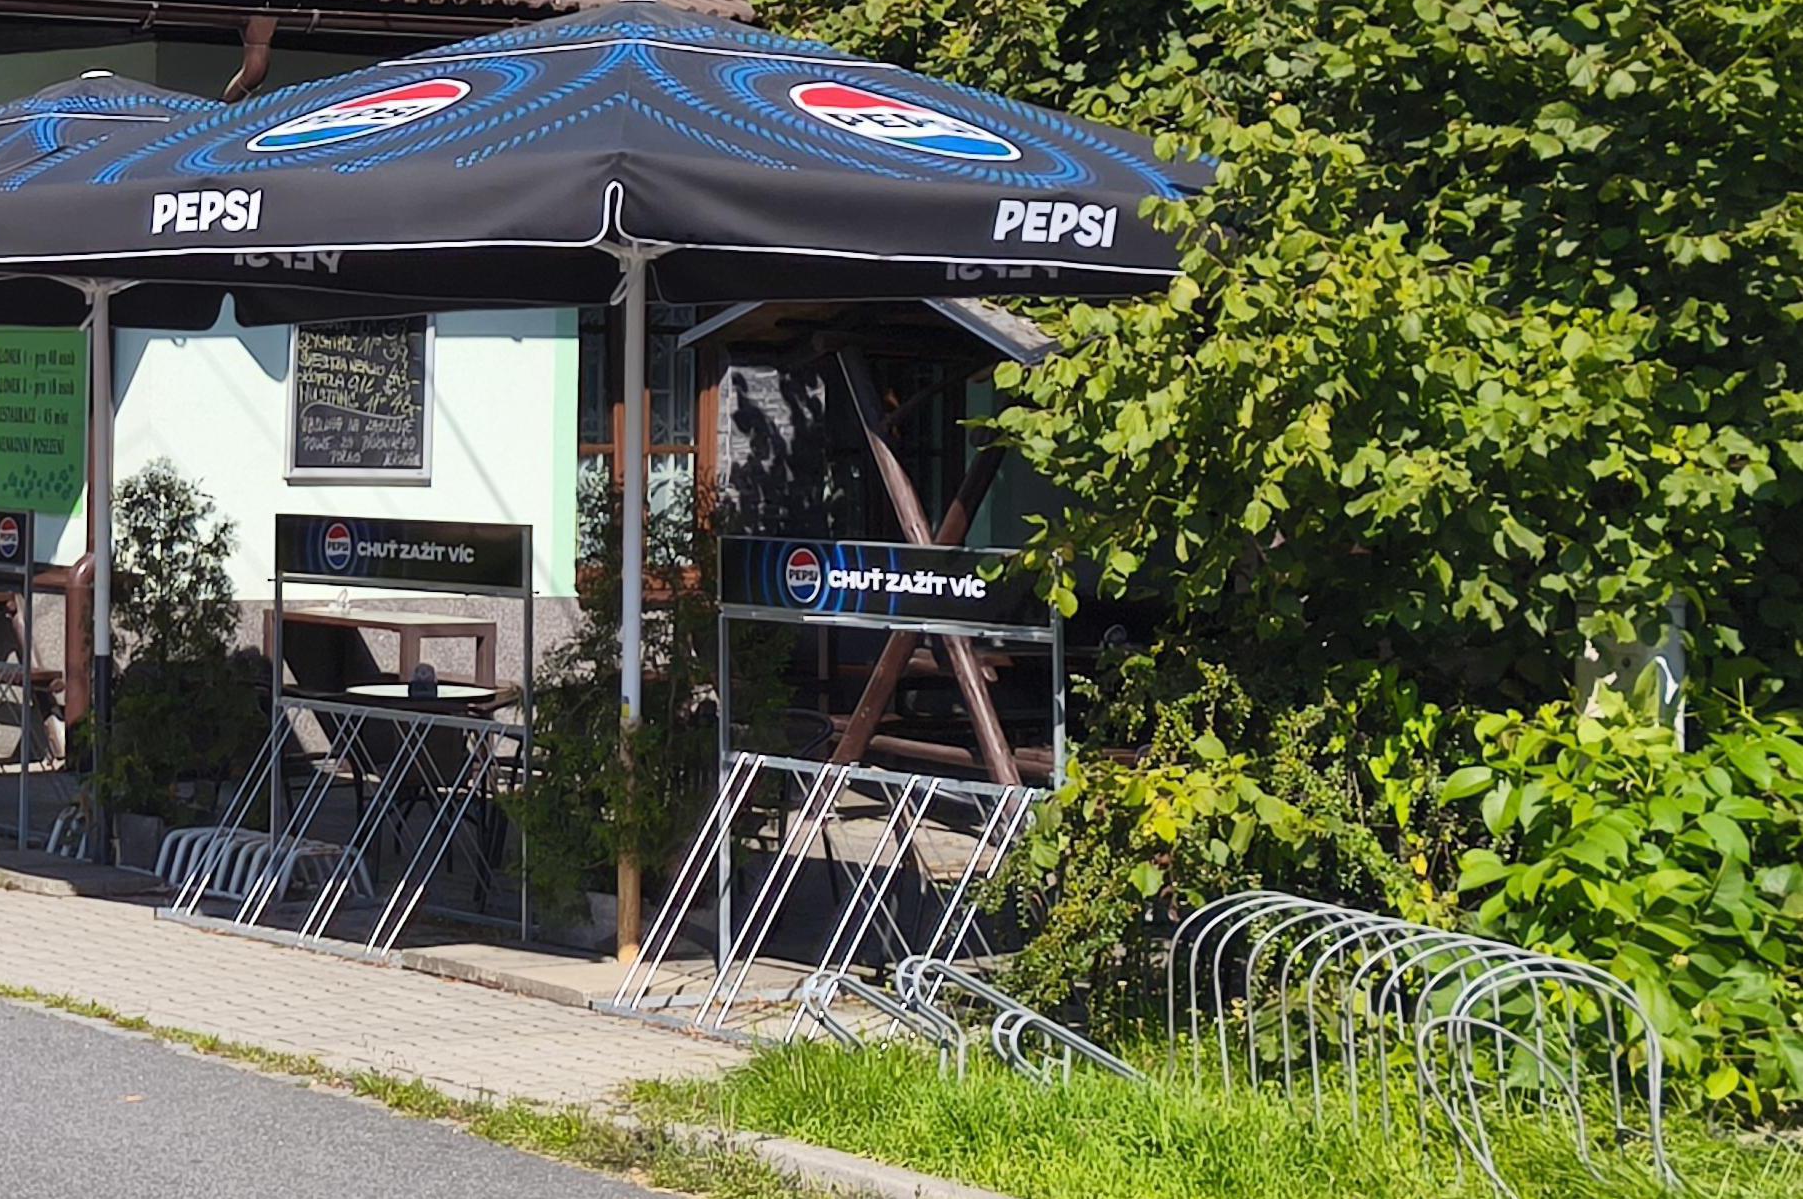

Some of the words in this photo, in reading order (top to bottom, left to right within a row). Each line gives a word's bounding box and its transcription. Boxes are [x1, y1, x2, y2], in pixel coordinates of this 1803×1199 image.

[151, 189, 263, 234] PEPSI
[993, 200, 1117, 248] PEPSI
[357, 540, 398, 559] CHUŤ
[400, 541, 445, 561] ZAŽÍT
[449, 542, 474, 563] VÍC
[789, 569, 819, 583] PEPSI
[828, 569, 885, 591] CHUŤ
[886, 569, 946, 595] ZAŽÍT
[949, 573, 986, 599] VÍC
